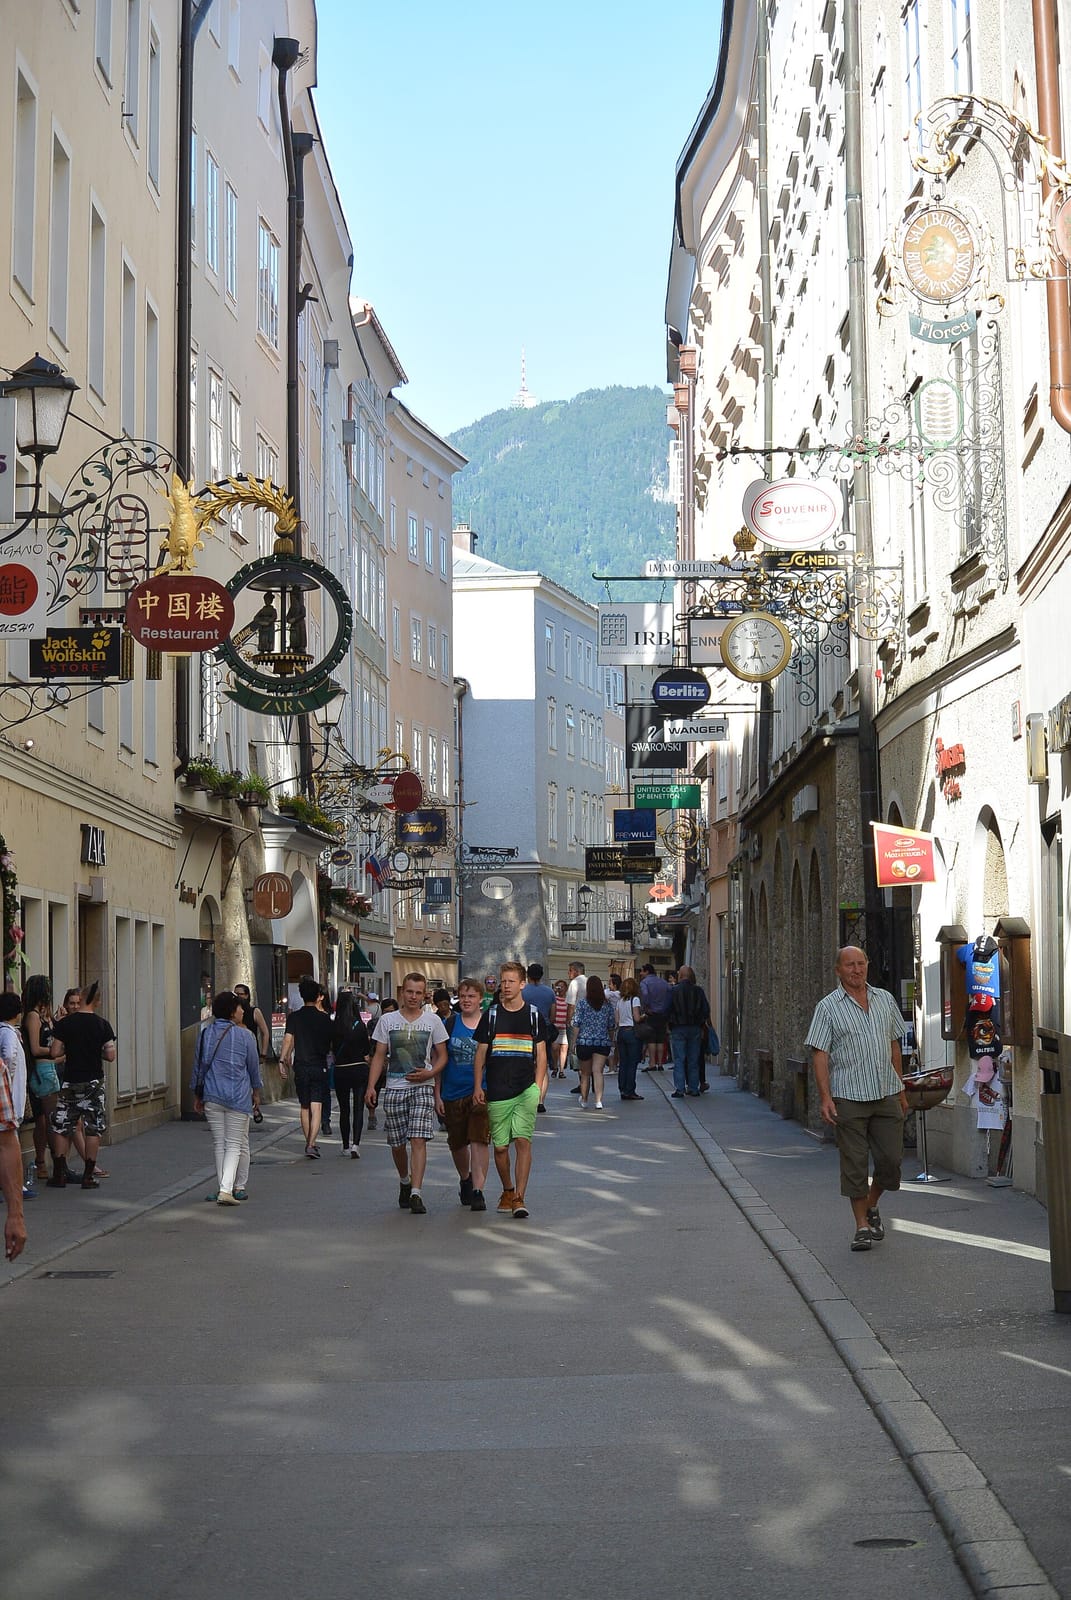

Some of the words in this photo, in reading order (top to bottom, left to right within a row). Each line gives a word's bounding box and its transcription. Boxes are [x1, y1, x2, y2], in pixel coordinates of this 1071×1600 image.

[907, 213, 970, 247] SALZBURGER
[649, 563, 717, 573] IMMOBILIEN
[137, 590, 225, 621] 中国楼
[140, 627, 219, 640] Restaurant
[634, 631, 671, 646] IRB
[42, 636, 78, 649] Jack
[42, 648, 106, 662] Wolfskin
[50, 663, 98, 673] STORE
[659, 685, 705, 697] Berlitz
[261, 700, 306, 712] ZARA
[668, 726, 725, 734] WANGER
[631, 742, 682, 752] SWAROVSKI
[388, 880, 421, 888] STAURANT
